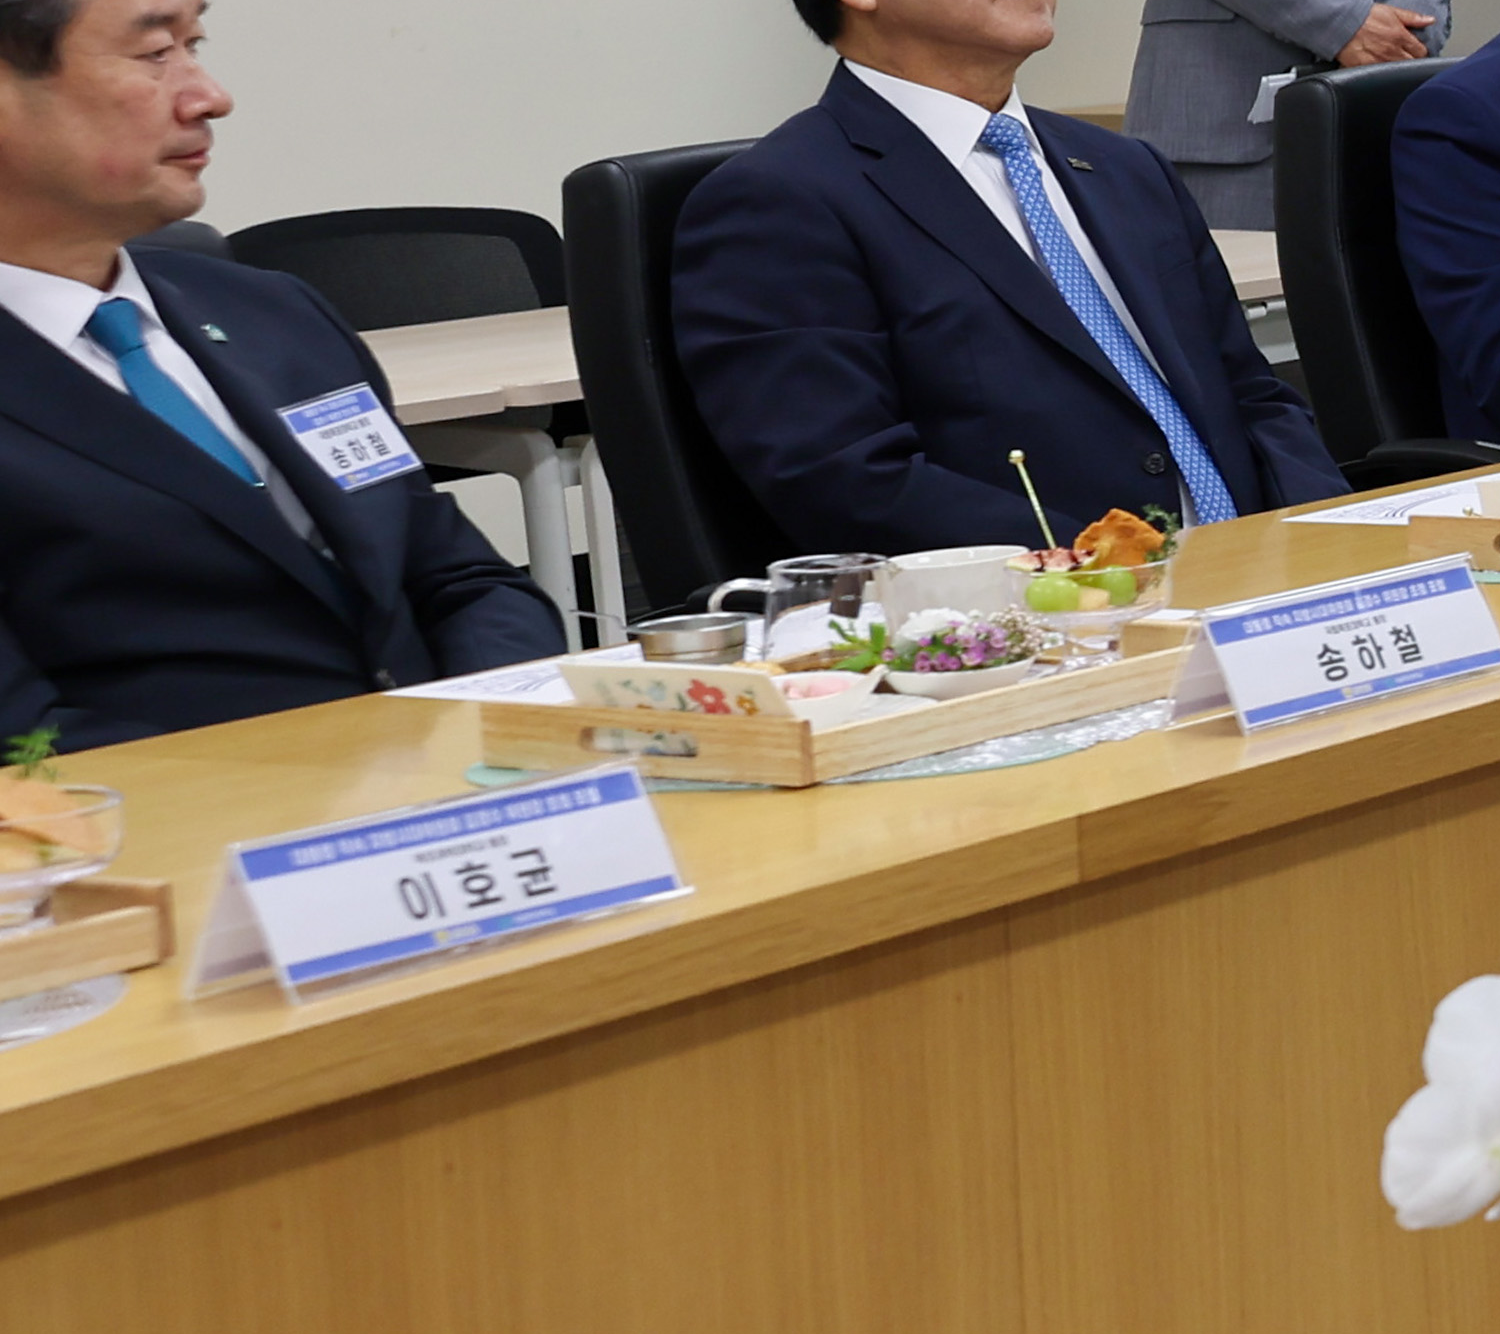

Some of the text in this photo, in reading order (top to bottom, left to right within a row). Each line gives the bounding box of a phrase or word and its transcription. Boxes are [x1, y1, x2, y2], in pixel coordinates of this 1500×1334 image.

[329, 431, 391, 469] 송하철
[1317, 624, 1424, 683] 송하철
[397, 847, 559, 920] 이호균
